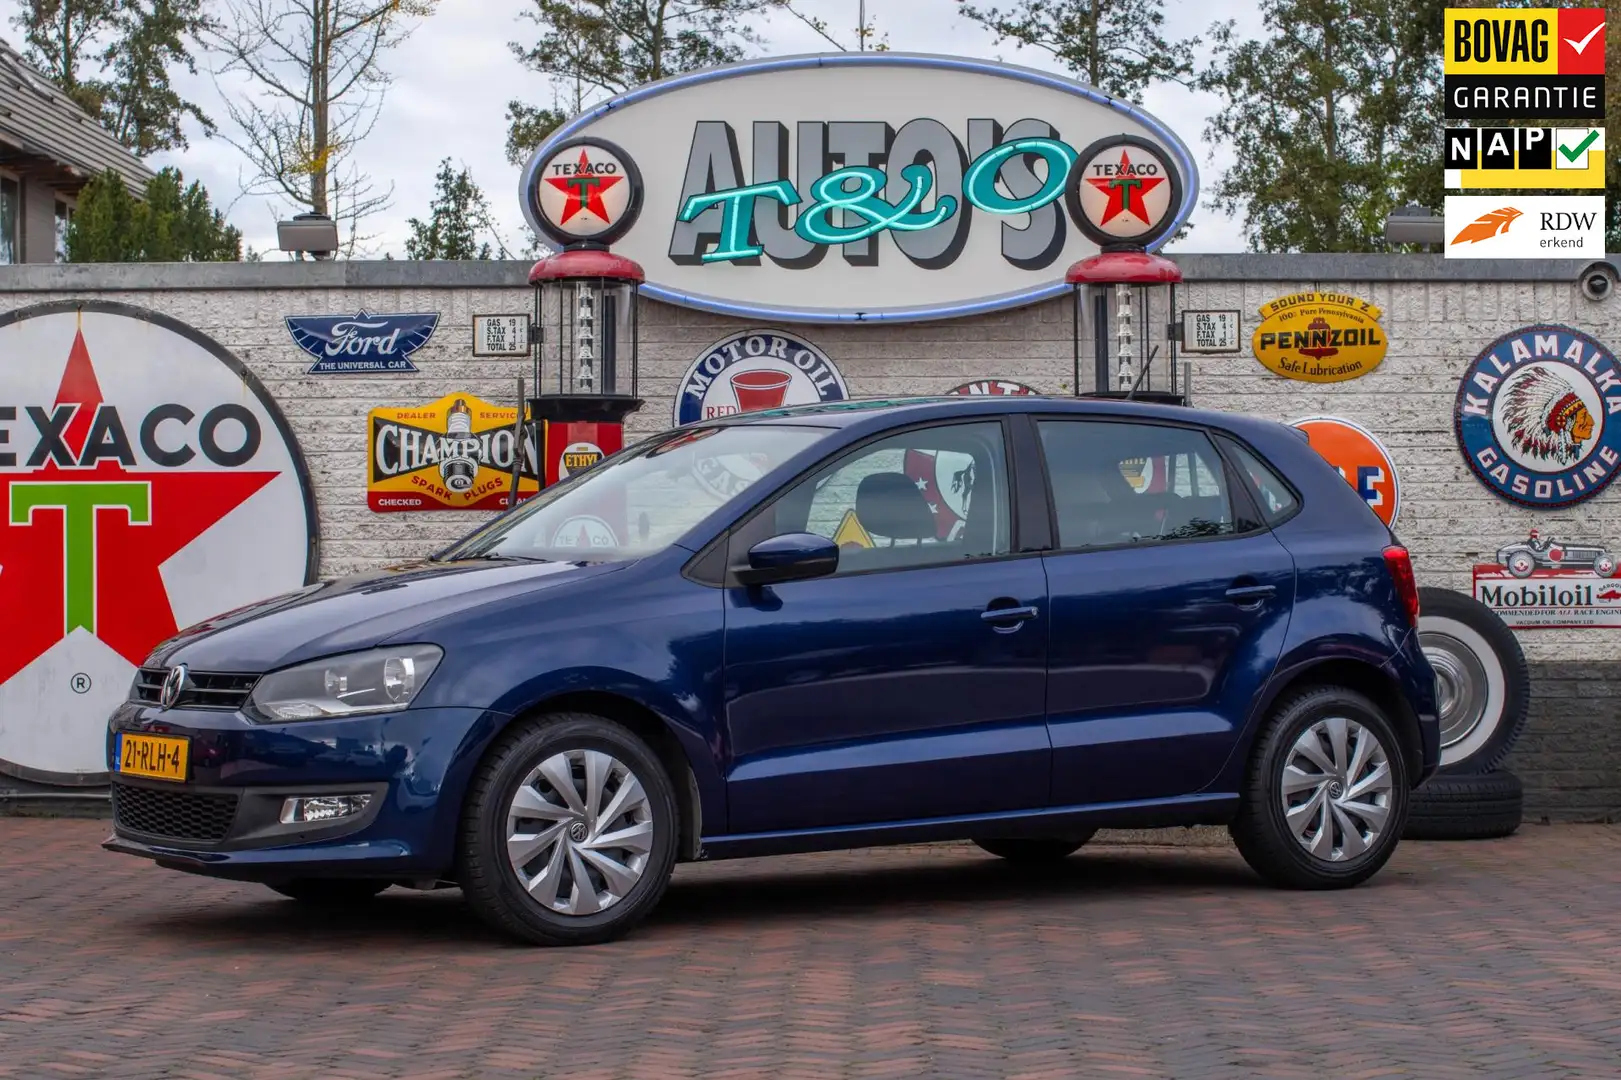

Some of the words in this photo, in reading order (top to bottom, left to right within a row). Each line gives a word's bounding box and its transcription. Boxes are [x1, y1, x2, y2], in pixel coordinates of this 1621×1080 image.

[552, 163, 616, 175] TEXACO
[1093, 164, 1158, 176] TEXACO
[668, 118, 1067, 270] AUTO'S
[1270, 294, 1314, 312] SOUND
[1319, 294, 1354, 306] YOUR
[1360, 302, 1370, 312] Z
[1196, 314, 1210, 322] GAS
[325, 321, 400, 356] Ford
[1260, 328, 1381, 350] PENNZOIL
[338, 361, 384, 369] UNIVERSAL
[685, 336, 789, 400] MOTOR
[794, 350, 837, 396] OIL
[1278, 356, 1301, 373] Safe
[1304, 360, 1362, 376] Lubrication
[376, 424, 538, 475] CHAMPION
[1476, 446, 1619, 498] GASOLINE
[412, 475, 454, 500] SPARK
[464, 477, 504, 500] PLUGS
[1480, 584, 1593, 607] Mobiloil
[124, 740, 180, 773] 21-RLH-4
